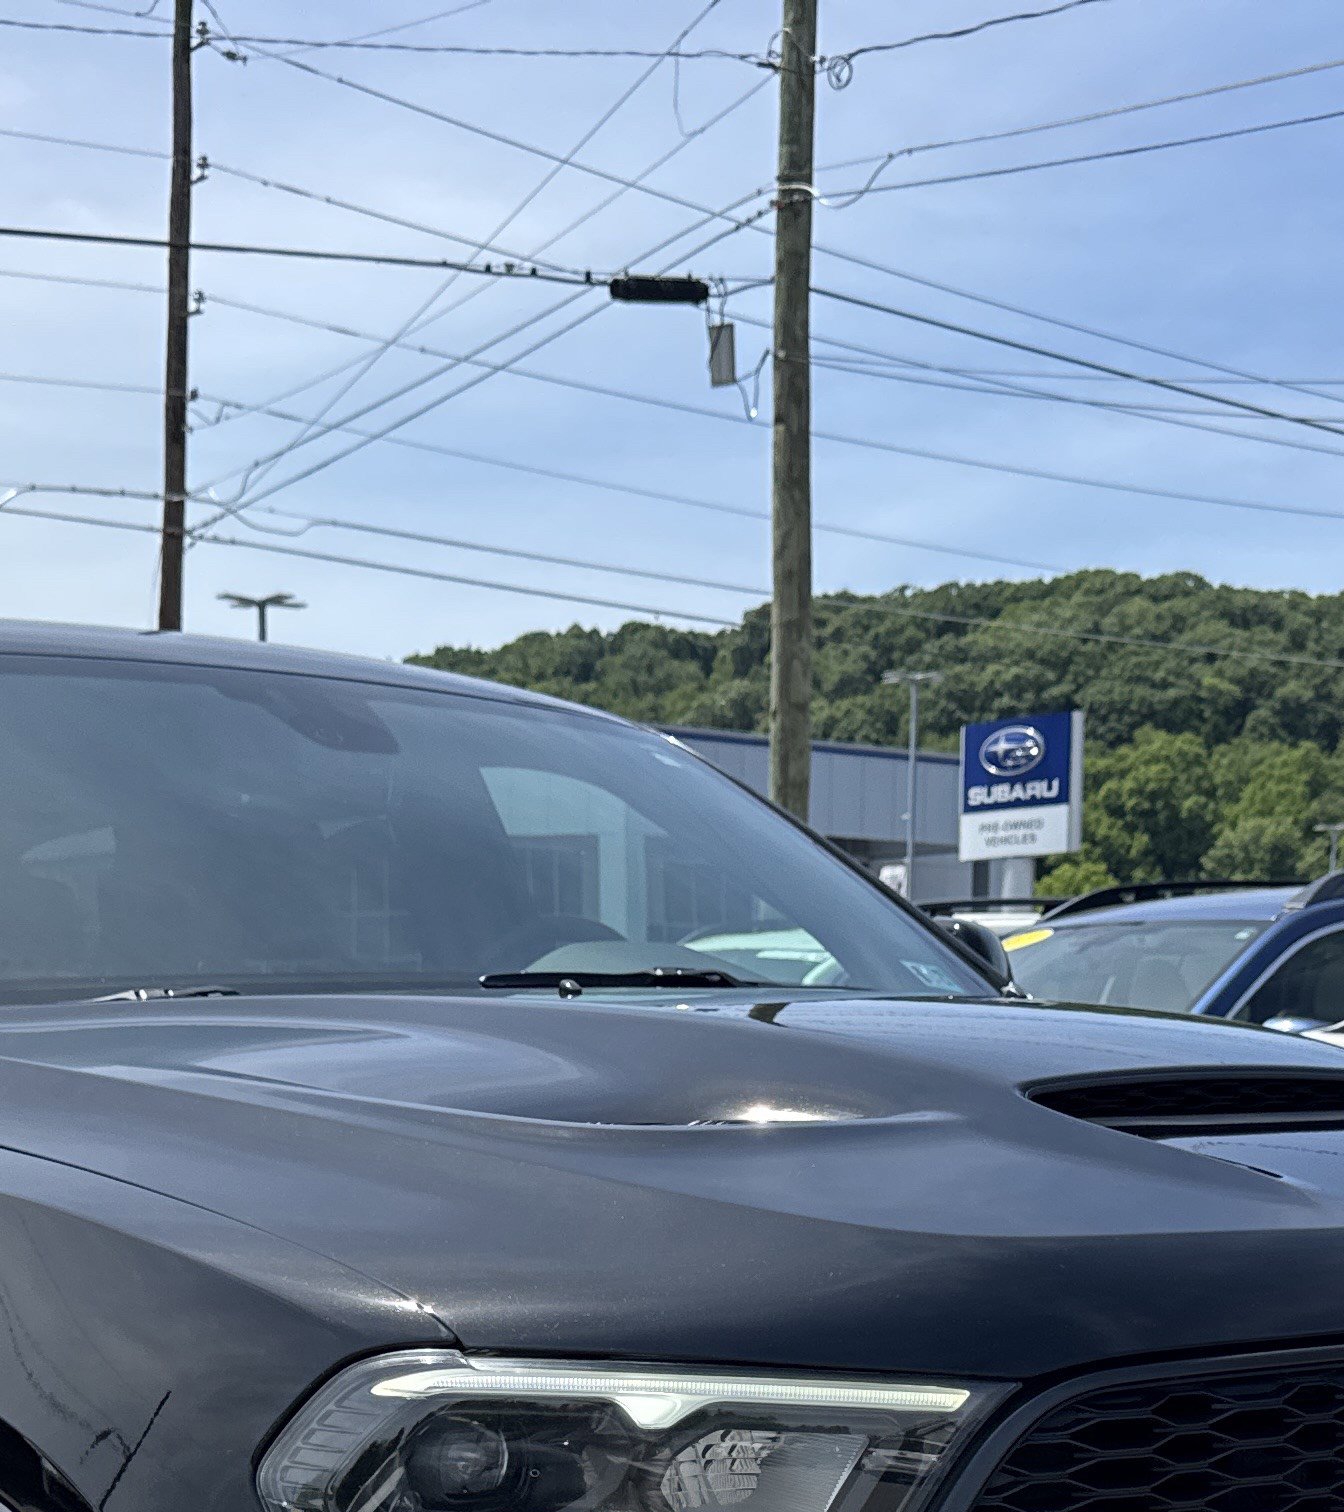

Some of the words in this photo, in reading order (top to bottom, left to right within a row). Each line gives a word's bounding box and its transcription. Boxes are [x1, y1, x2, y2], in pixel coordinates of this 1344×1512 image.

[968, 778, 1059, 806] SUBARU
[980, 818, 1043, 832] PRE-OWNED
[986, 834, 1036, 847] VEHICLES
